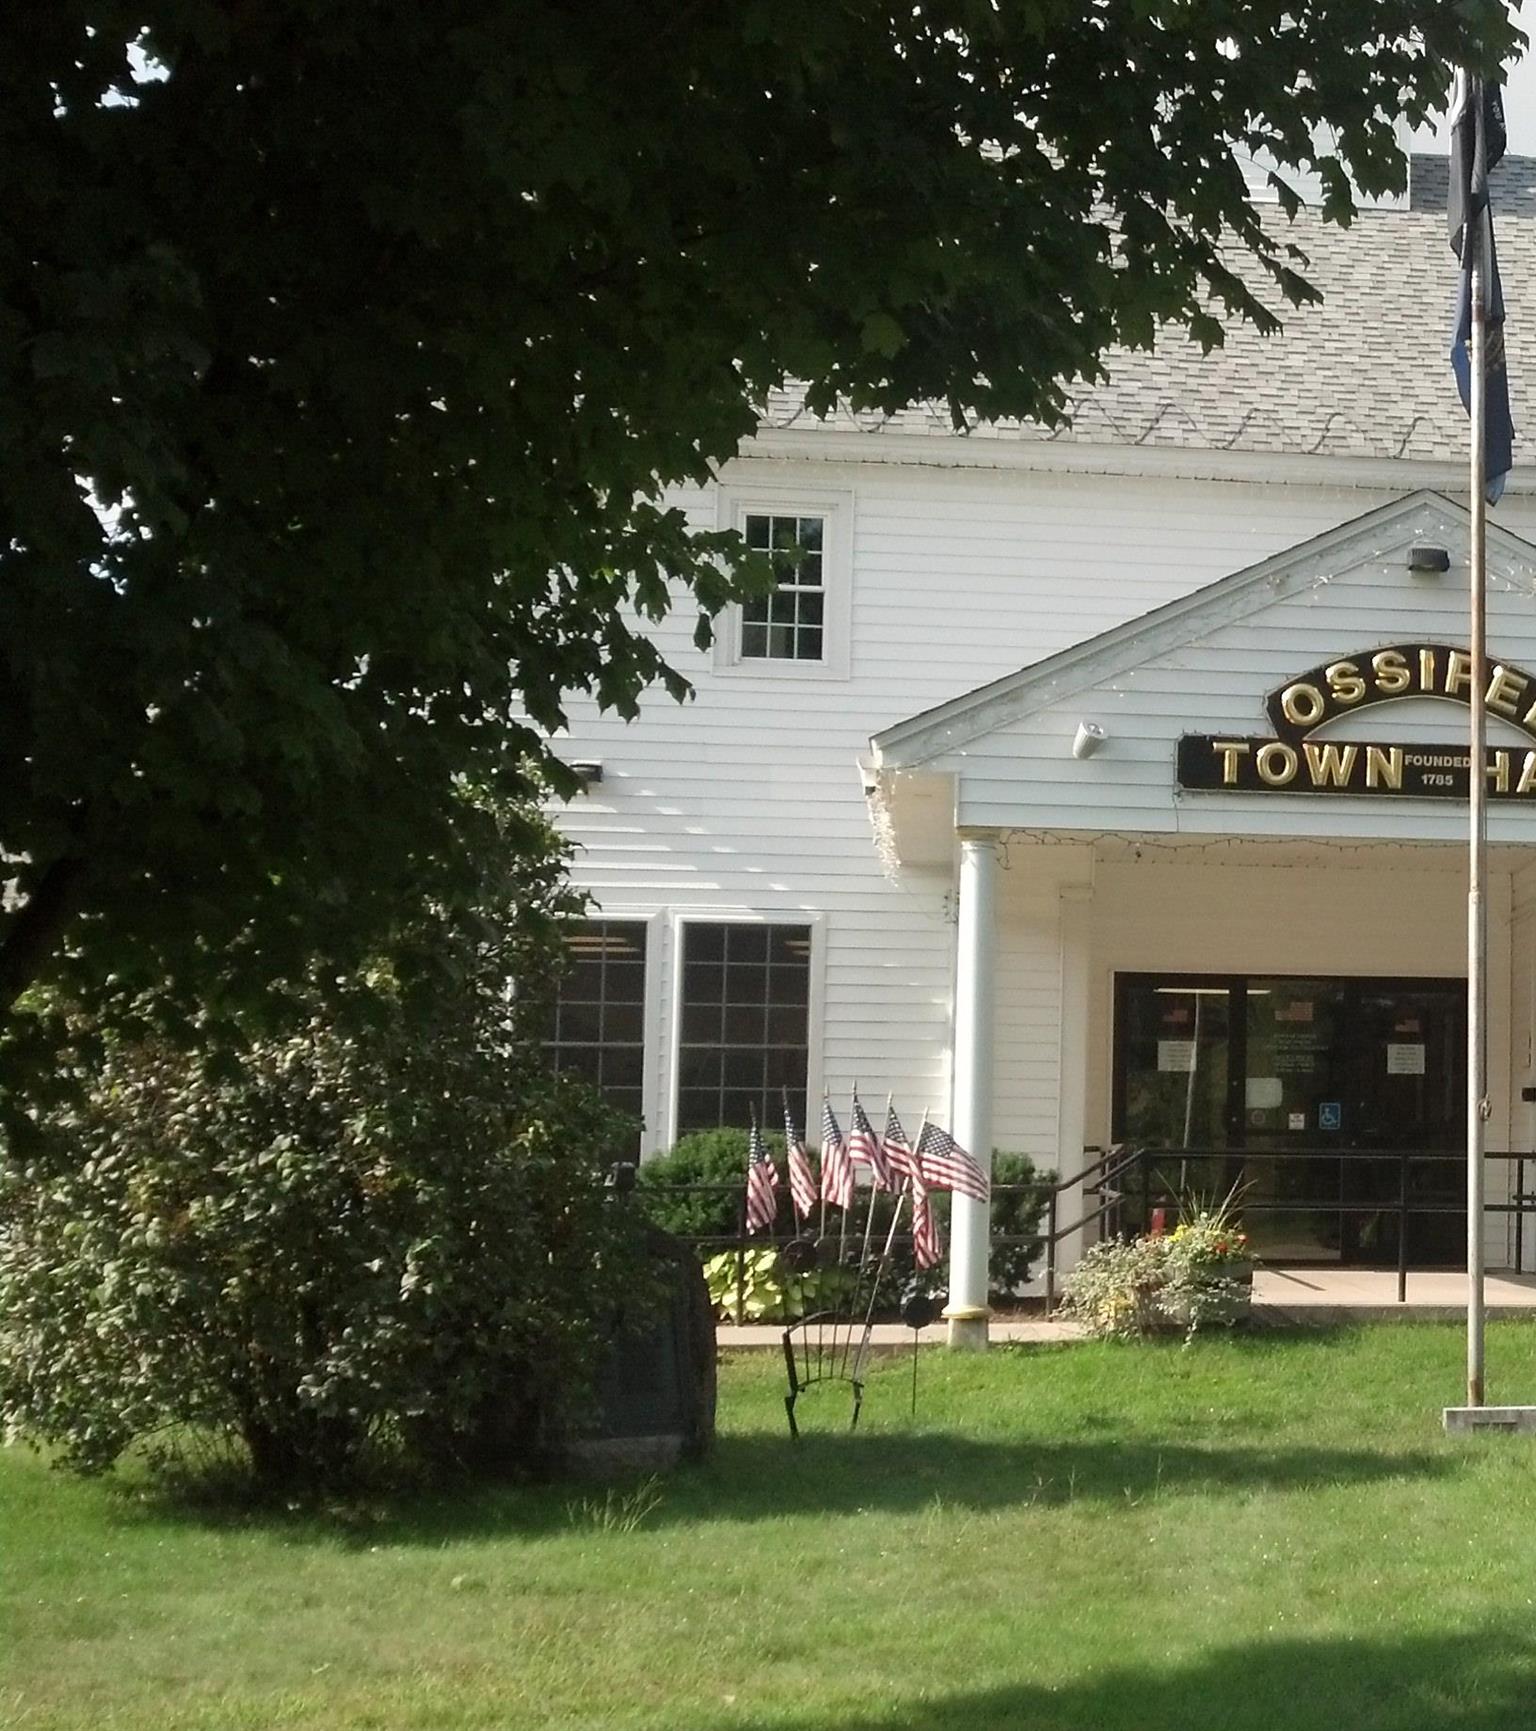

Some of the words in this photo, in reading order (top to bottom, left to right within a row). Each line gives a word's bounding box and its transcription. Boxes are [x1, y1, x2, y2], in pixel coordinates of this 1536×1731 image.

[1212, 741, 1402, 789] TOWN
[1404, 754, 1471, 768] FOUNDED
[1421, 774, 1454, 786] 1785
